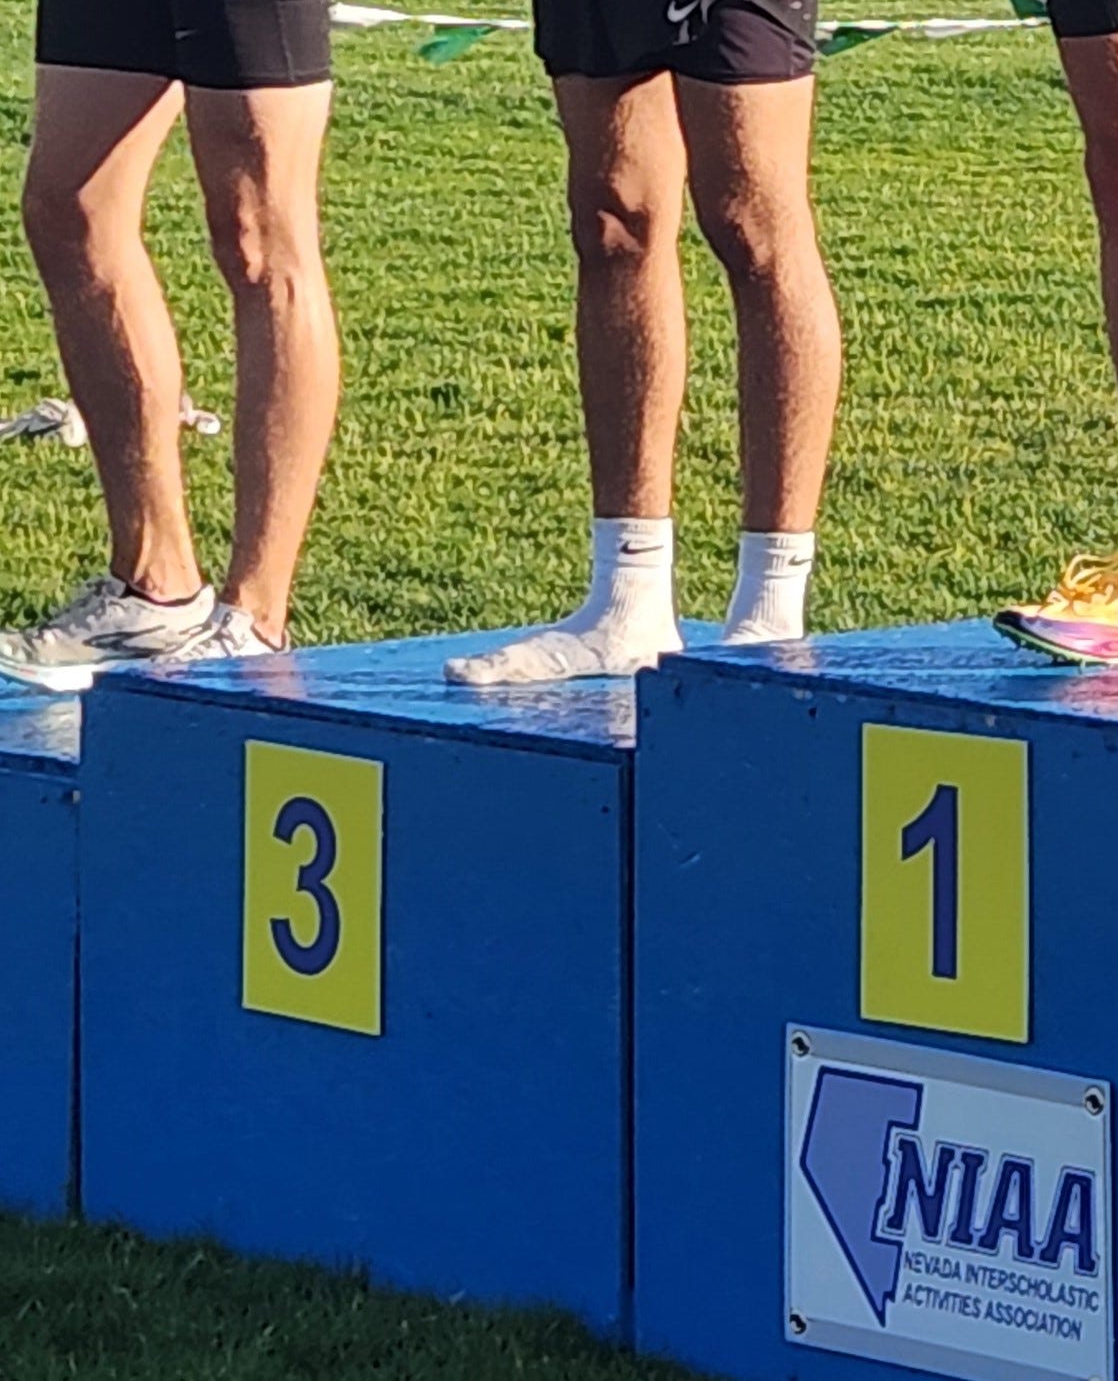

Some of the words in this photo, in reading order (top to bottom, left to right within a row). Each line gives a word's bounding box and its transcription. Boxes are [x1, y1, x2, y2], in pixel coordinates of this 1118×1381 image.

[270, 796, 341, 976] 3
[901, 783, 959, 980] 1
[883, 1135, 1099, 1274] NIAA
[903, 1282, 982, 1319] ACTIVITIES
[984, 1300, 1083, 1341] ASSOCIATION
[904, 1250, 962, 1285] NEVADA
[963, 1263, 1100, 1312] INTERSCHOLASTIC
